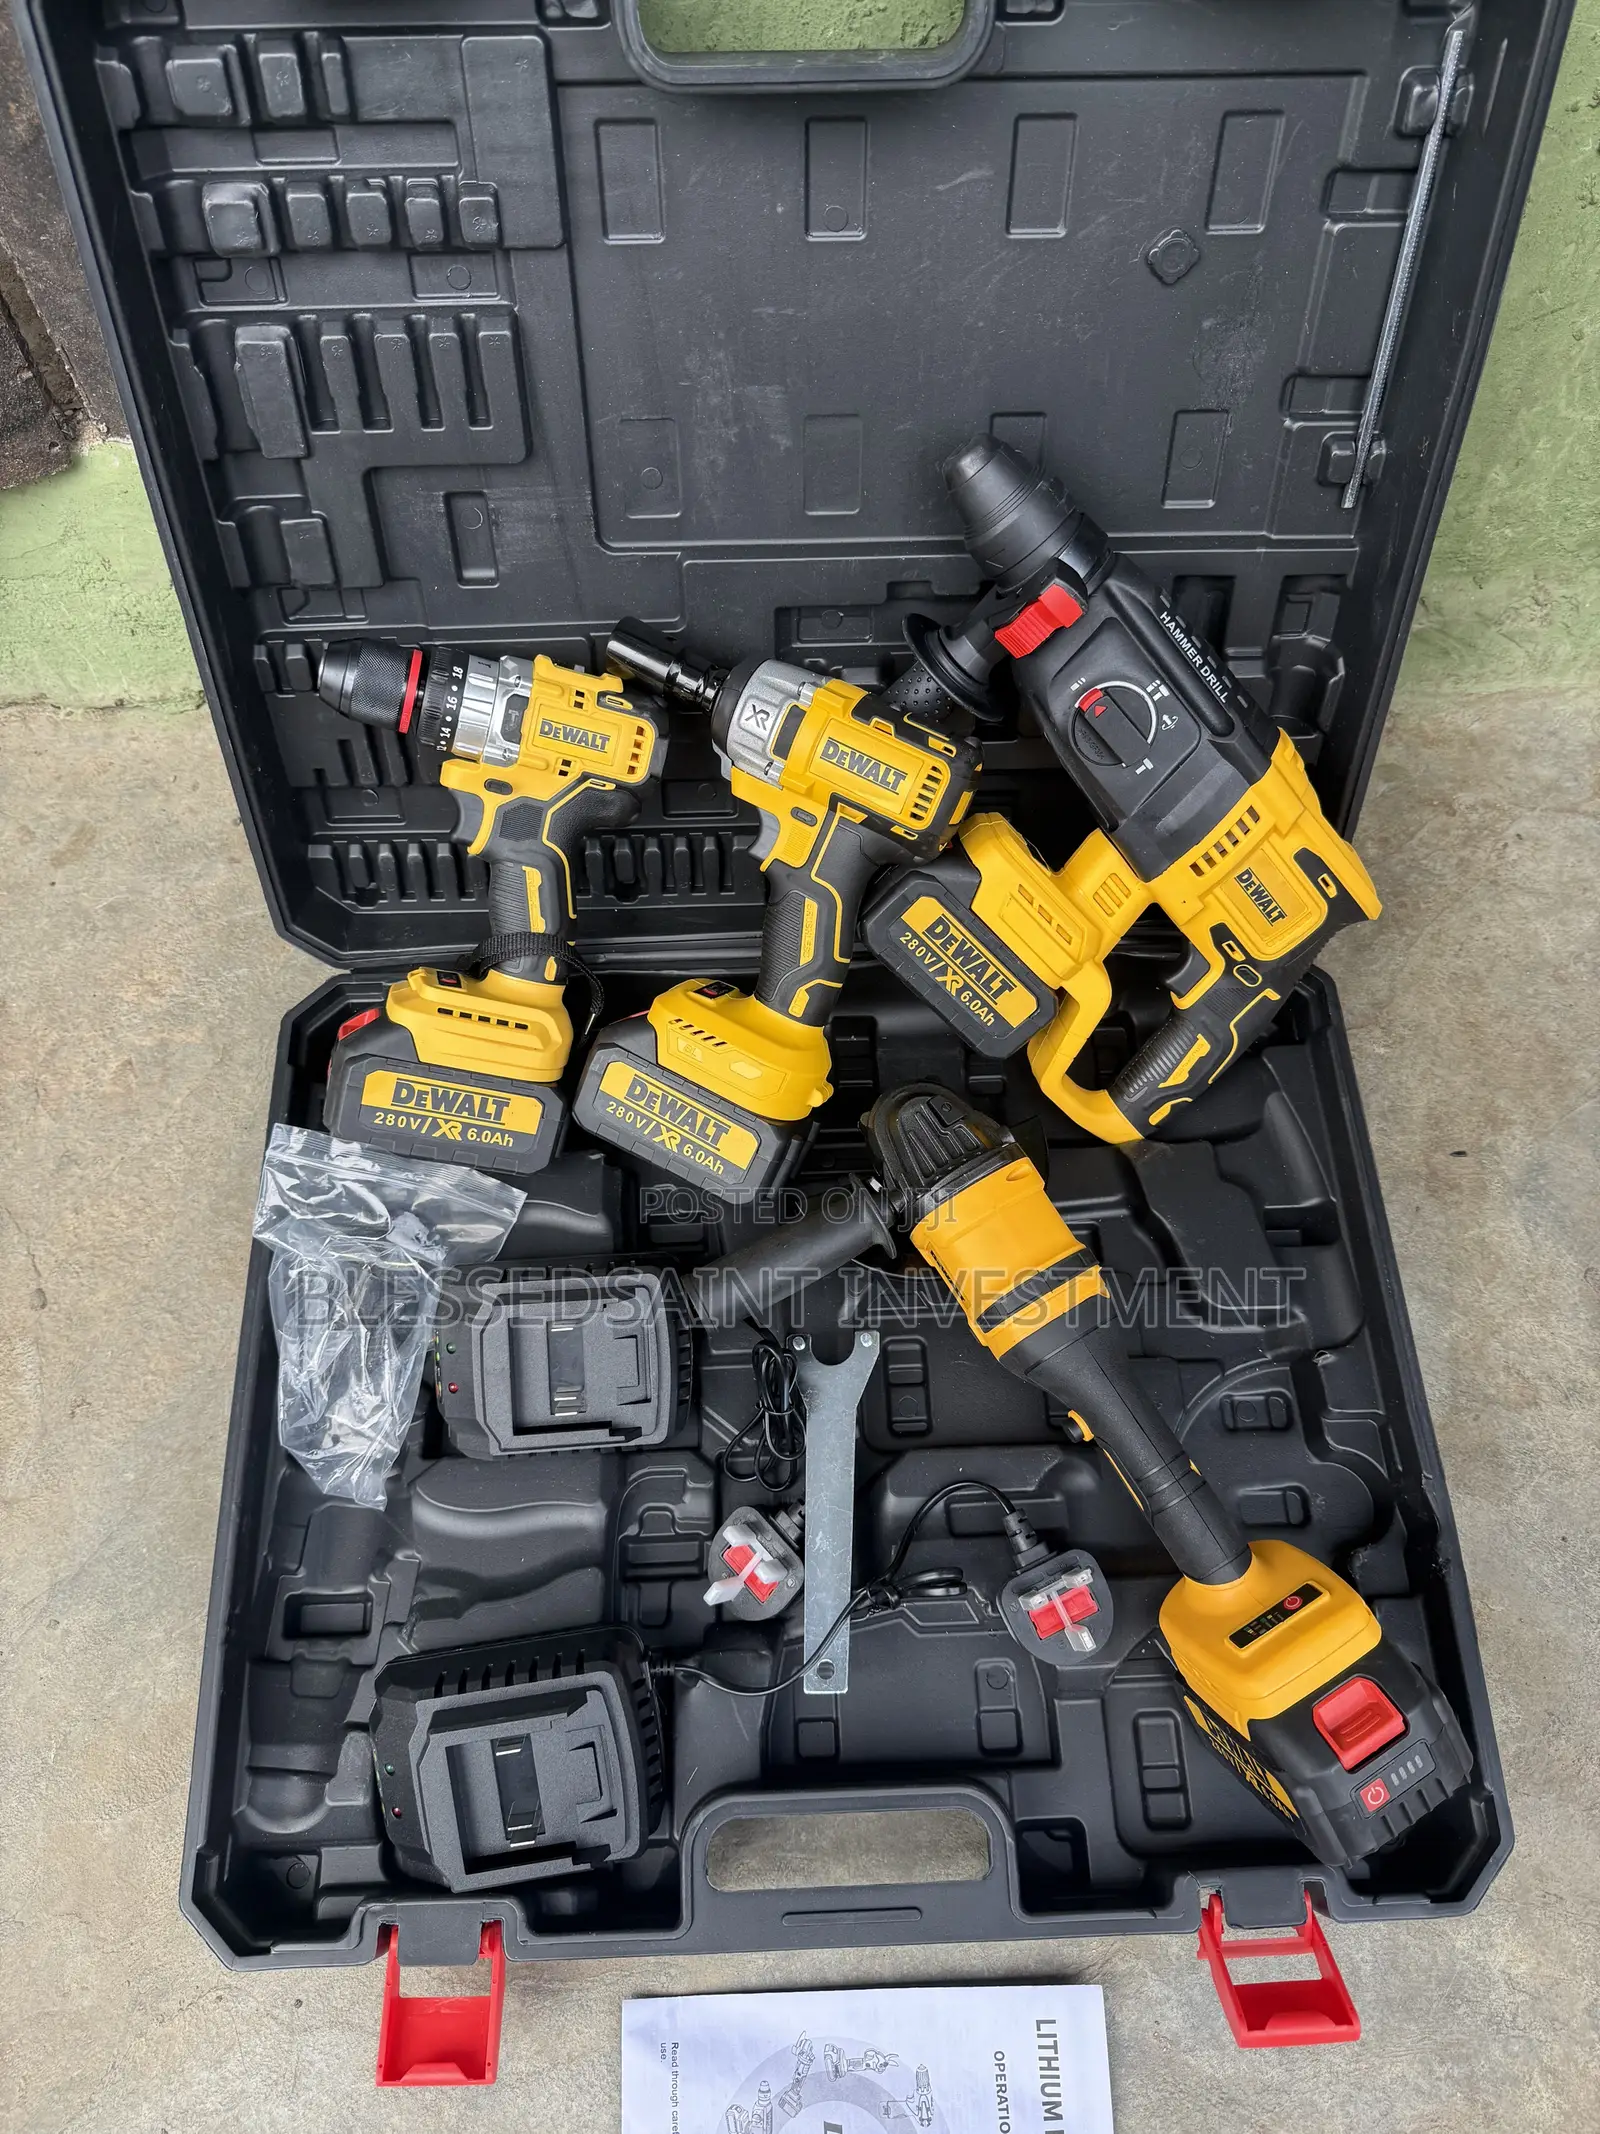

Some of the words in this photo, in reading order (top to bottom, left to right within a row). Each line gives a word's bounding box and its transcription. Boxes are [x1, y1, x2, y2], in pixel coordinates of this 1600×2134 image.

[1160, 611, 1203, 668] HAMMER
[1200, 665, 1228, 703] DRILL
[440, 727, 452, 738] 14
[446, 696, 458, 710] 16
[452, 666, 464, 679] 18
[960, 990, 995, 1027] 6.0Ah
[467, 1128, 514, 1147] 6.0Ah
[683, 1143, 724, 1176] 6.0Ah
[670, 2070, 679, 2107] through
[994, 2050, 1011, 2134] OPERATIO
[1036, 2019, 1063, 2121] LITHIUM
